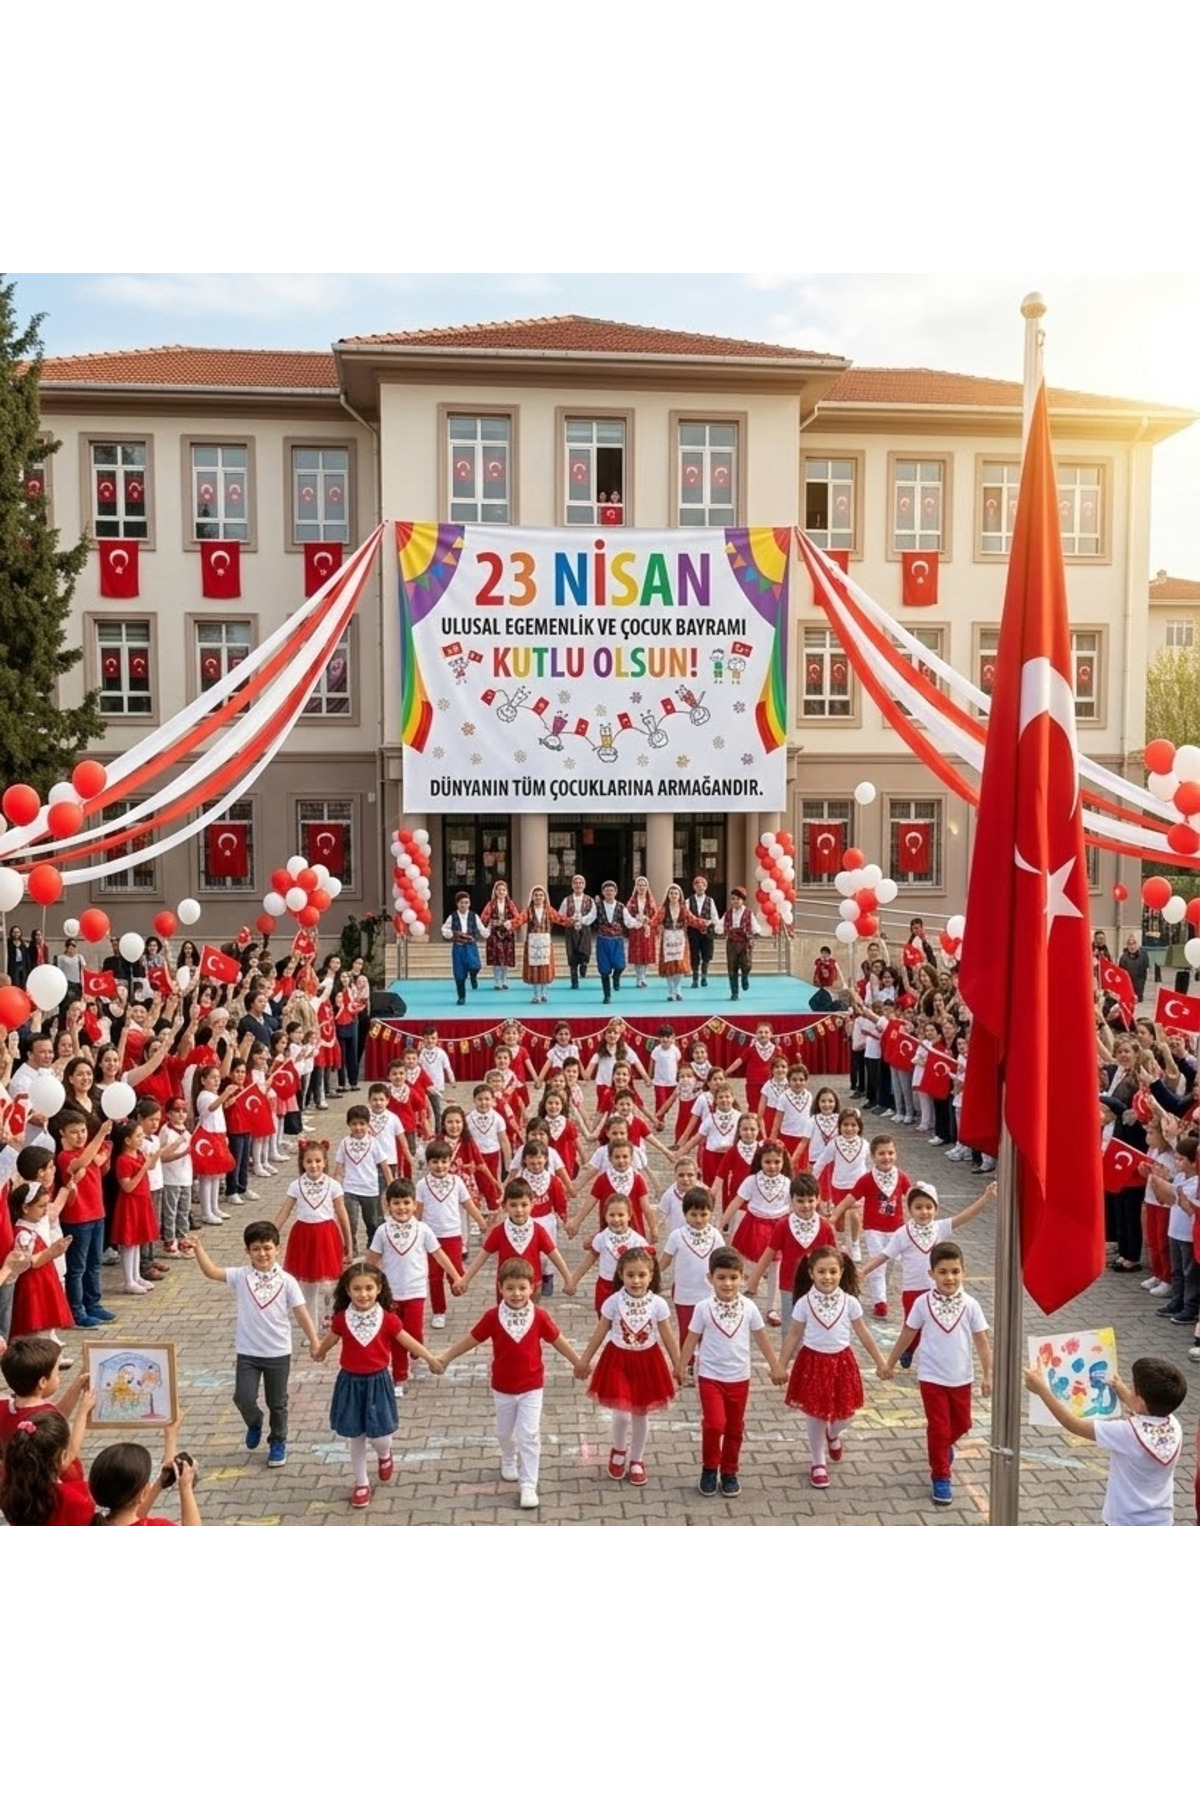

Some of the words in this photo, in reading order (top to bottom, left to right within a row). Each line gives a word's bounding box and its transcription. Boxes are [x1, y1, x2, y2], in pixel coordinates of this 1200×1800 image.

[475, 552, 537, 607] 23
[555, 539, 710, 607] NİSAN
[442, 617, 500, 636] ULUSAL
[505, 614, 594, 636] EGEMENLİK
[598, 618, 616, 636] VE
[621, 618, 671, 640] ÇOCUK
[676, 618, 746, 636] BAYRAMI
[493, 646, 584, 678] KUTLU
[593, 646, 698, 678] OLSUN!
[430, 776, 508, 797] DÜNYANIN
[512, 776, 546, 797] TÜM
[549, 779, 653, 802] ÇOCUKLARINA
[658, 775, 763, 797] ARMAĞANDIR.
